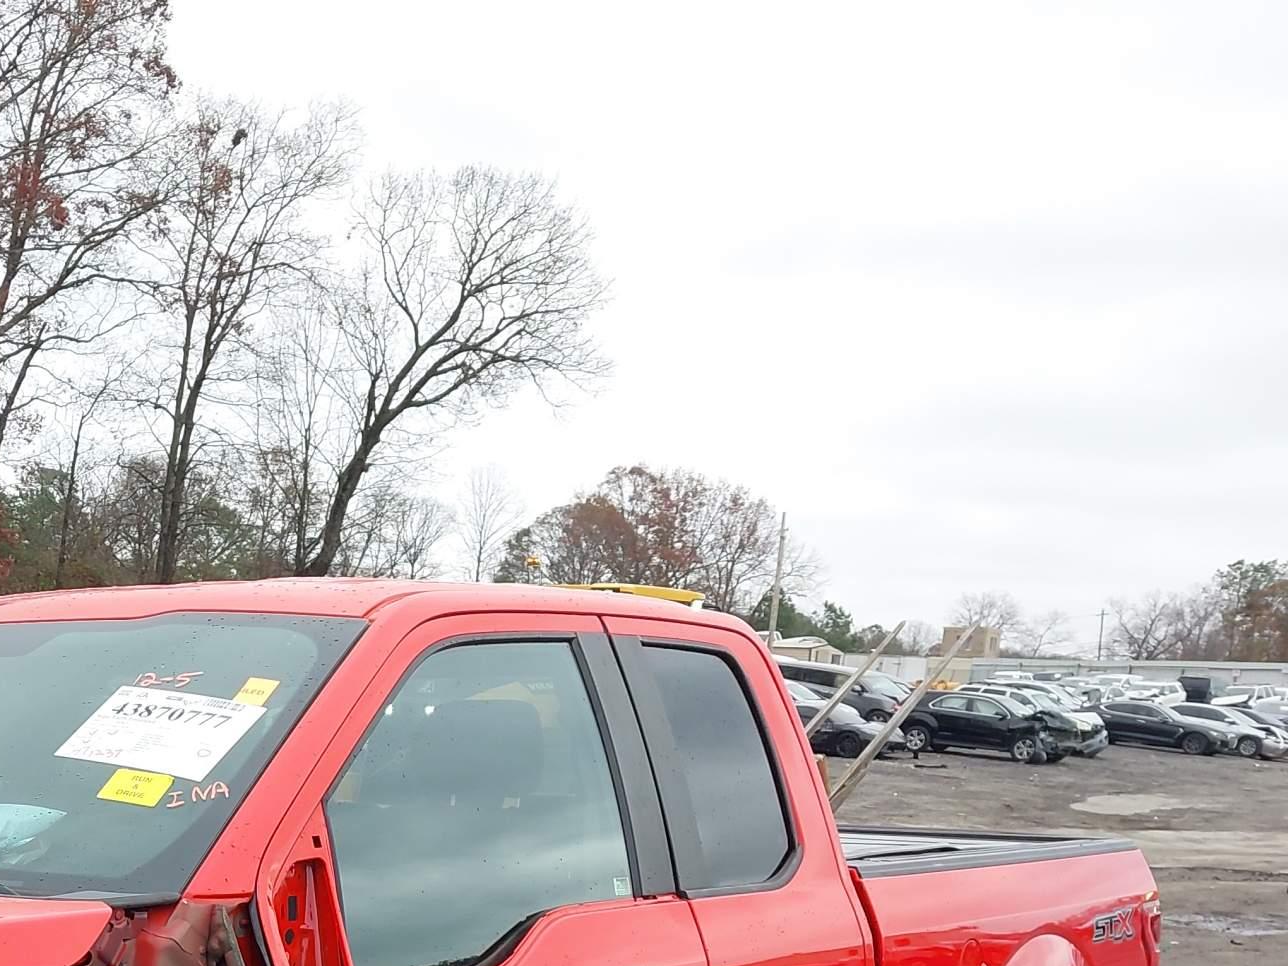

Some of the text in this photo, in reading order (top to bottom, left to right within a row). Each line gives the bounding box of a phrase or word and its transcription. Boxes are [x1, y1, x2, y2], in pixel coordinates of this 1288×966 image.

[111, 701, 232, 729] 43870777
[131, 774, 154, 783] RUN
[115, 788, 145, 799] DRIVE
[1093, 907, 1133, 943] STX
